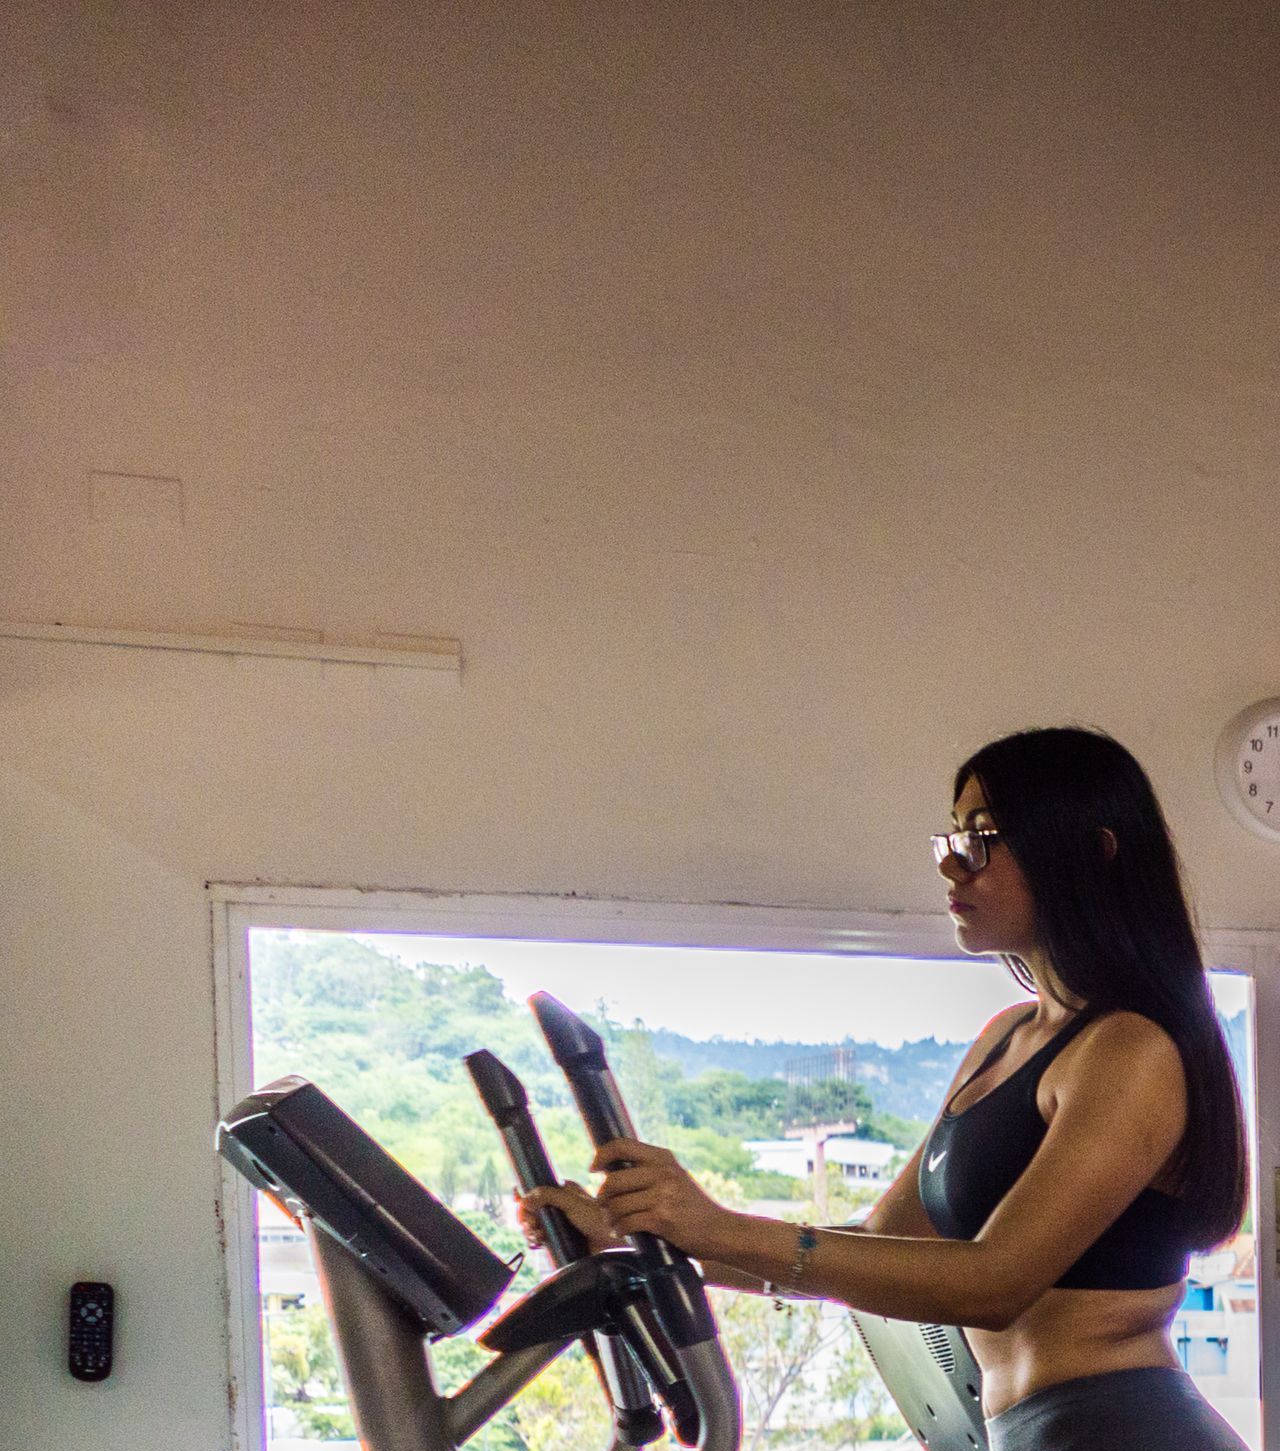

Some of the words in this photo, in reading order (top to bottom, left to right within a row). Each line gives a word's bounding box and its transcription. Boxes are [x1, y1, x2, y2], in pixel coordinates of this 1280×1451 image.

[1267, 725, 1278, 738] 11
[1251, 739, 1263, 752] 10
[1244, 761, 1252, 774] 9
[1249, 783, 1257, 797] 8
[1266, 801, 1274, 813] 7
